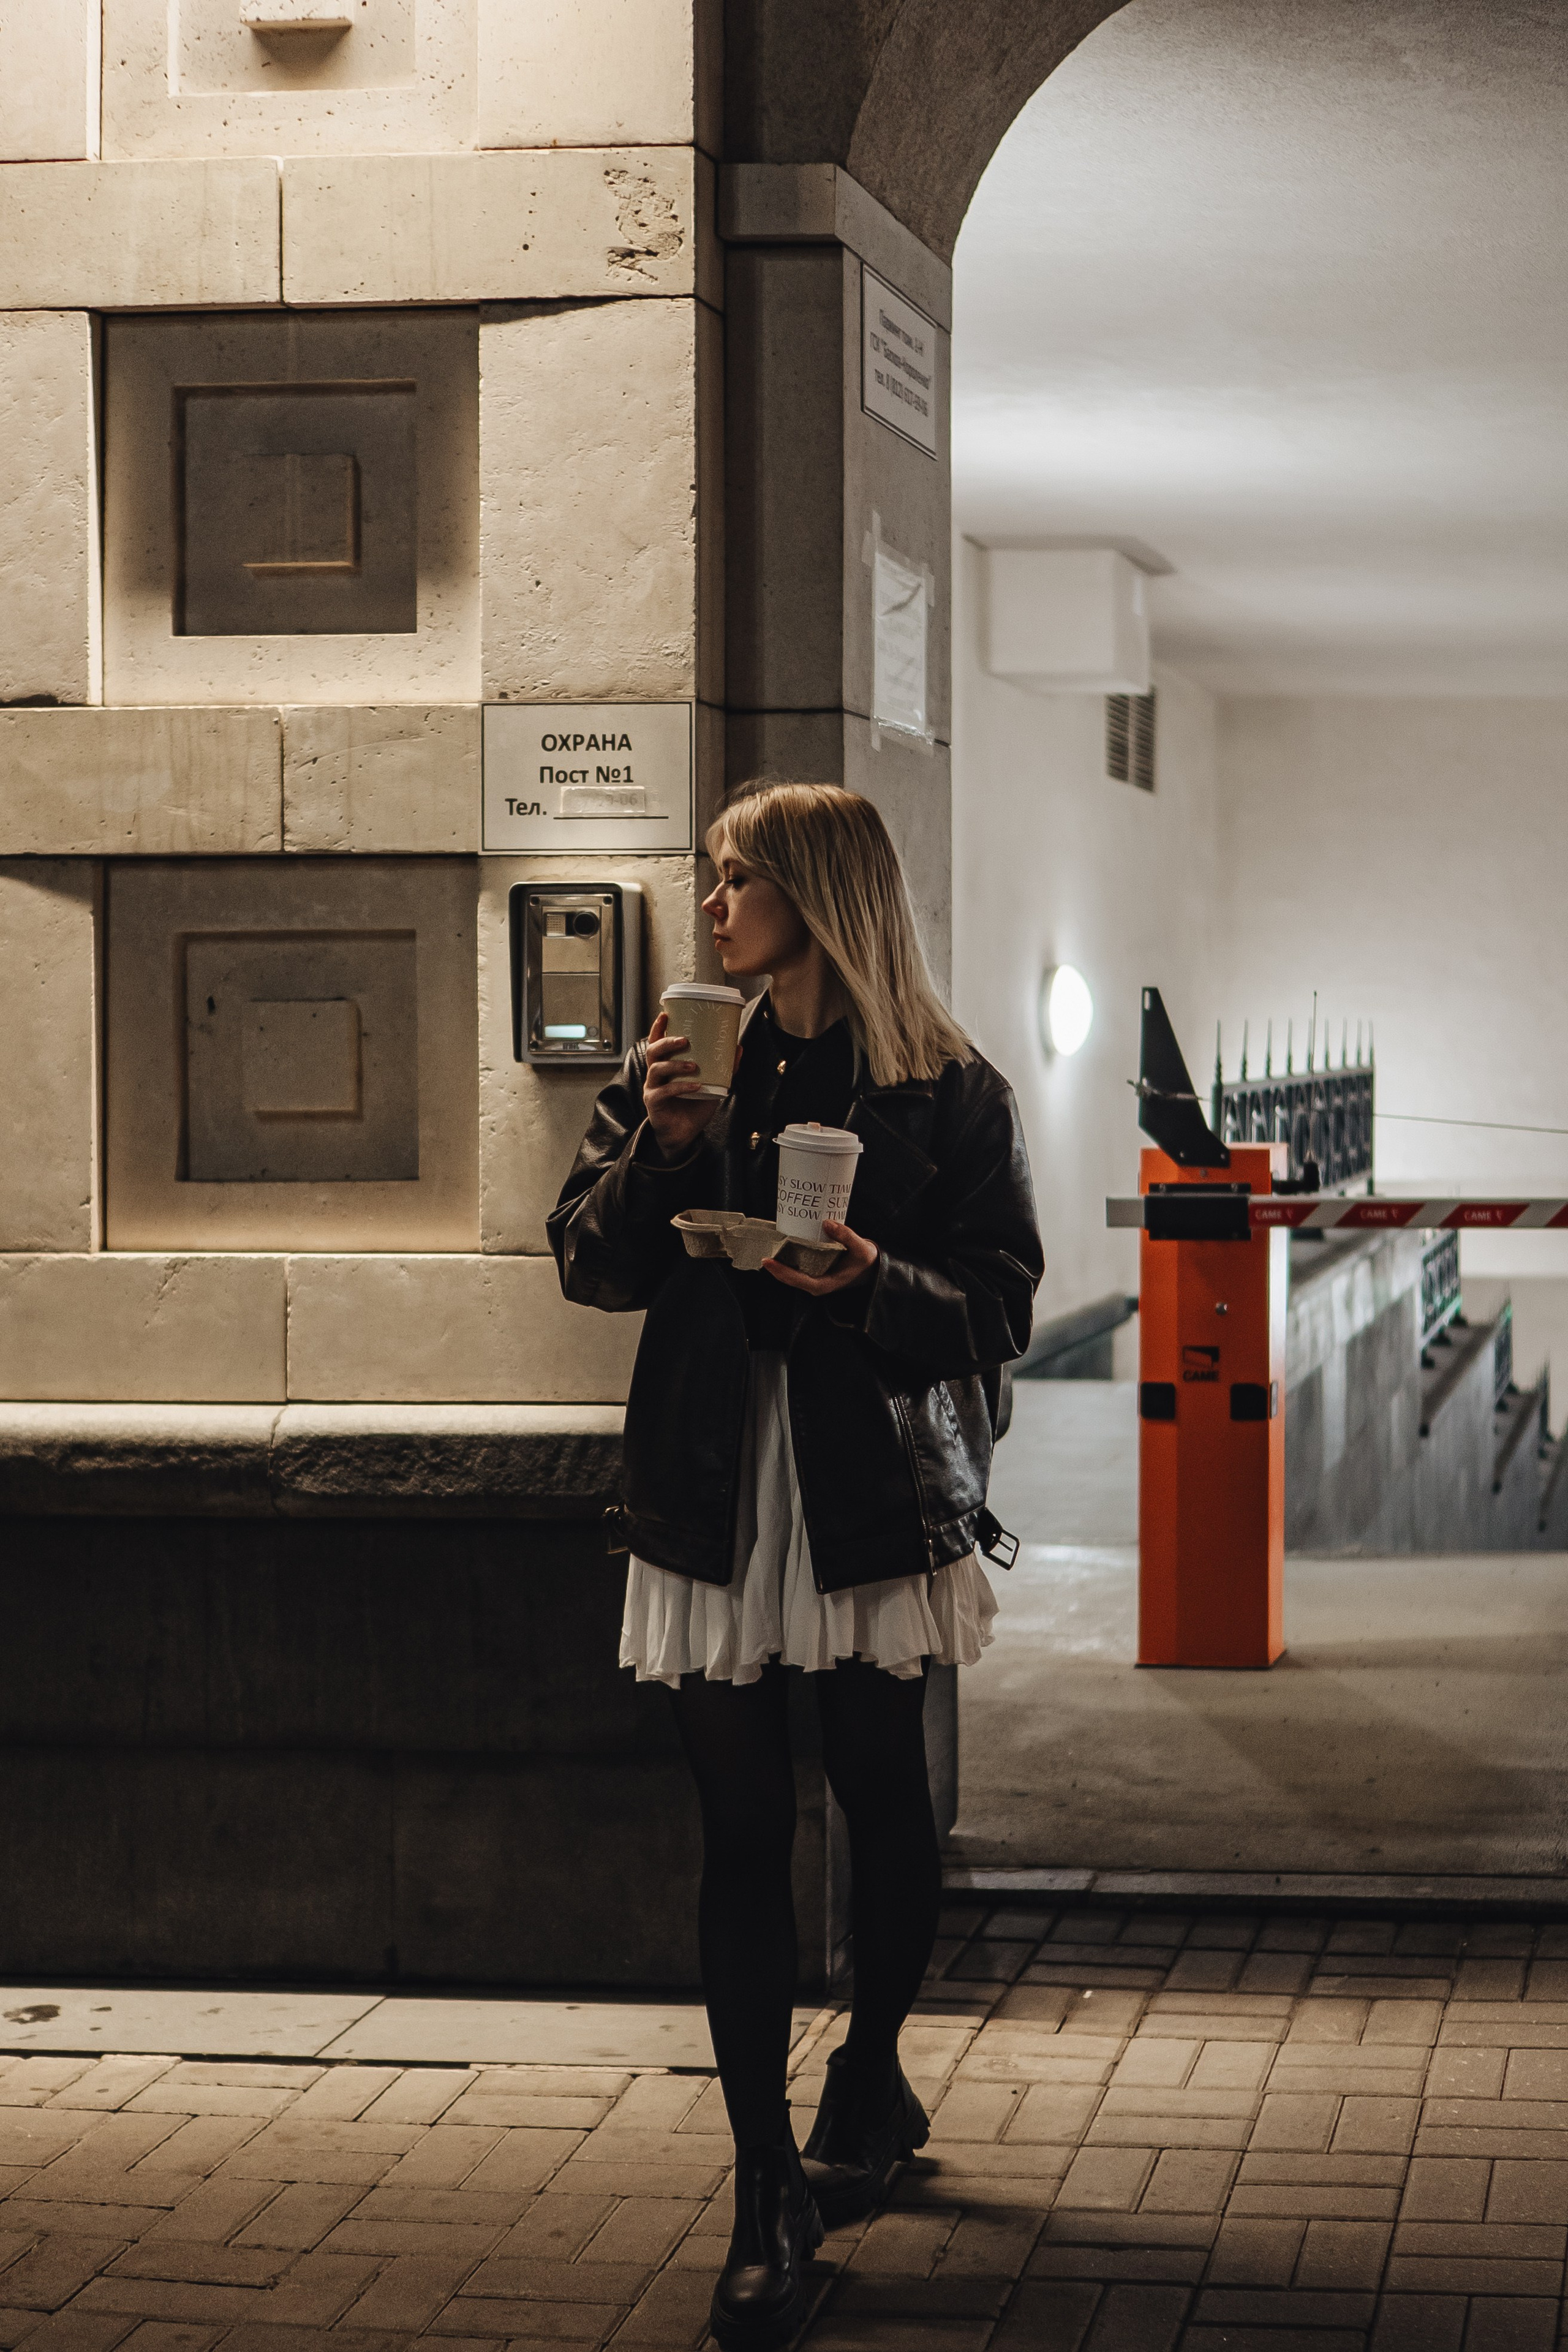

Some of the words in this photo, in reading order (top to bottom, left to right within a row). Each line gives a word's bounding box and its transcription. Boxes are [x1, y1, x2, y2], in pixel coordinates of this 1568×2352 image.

[541, 733, 632, 752] ОХРАНА
[540, 766, 589, 783] Пост
[596, 766, 634, 783] №1
[505, 797, 547, 816] Тел.
[790, 1178, 827, 1193] SLOW
[788, 1205, 821, 1221] SLOW
[1254, 1208, 1283, 1220] CAME
[1360, 1208, 1388, 1220] CAME
[1463, 1210, 1492, 1222] CAME
[1183, 1370, 1219, 1382] CAME
